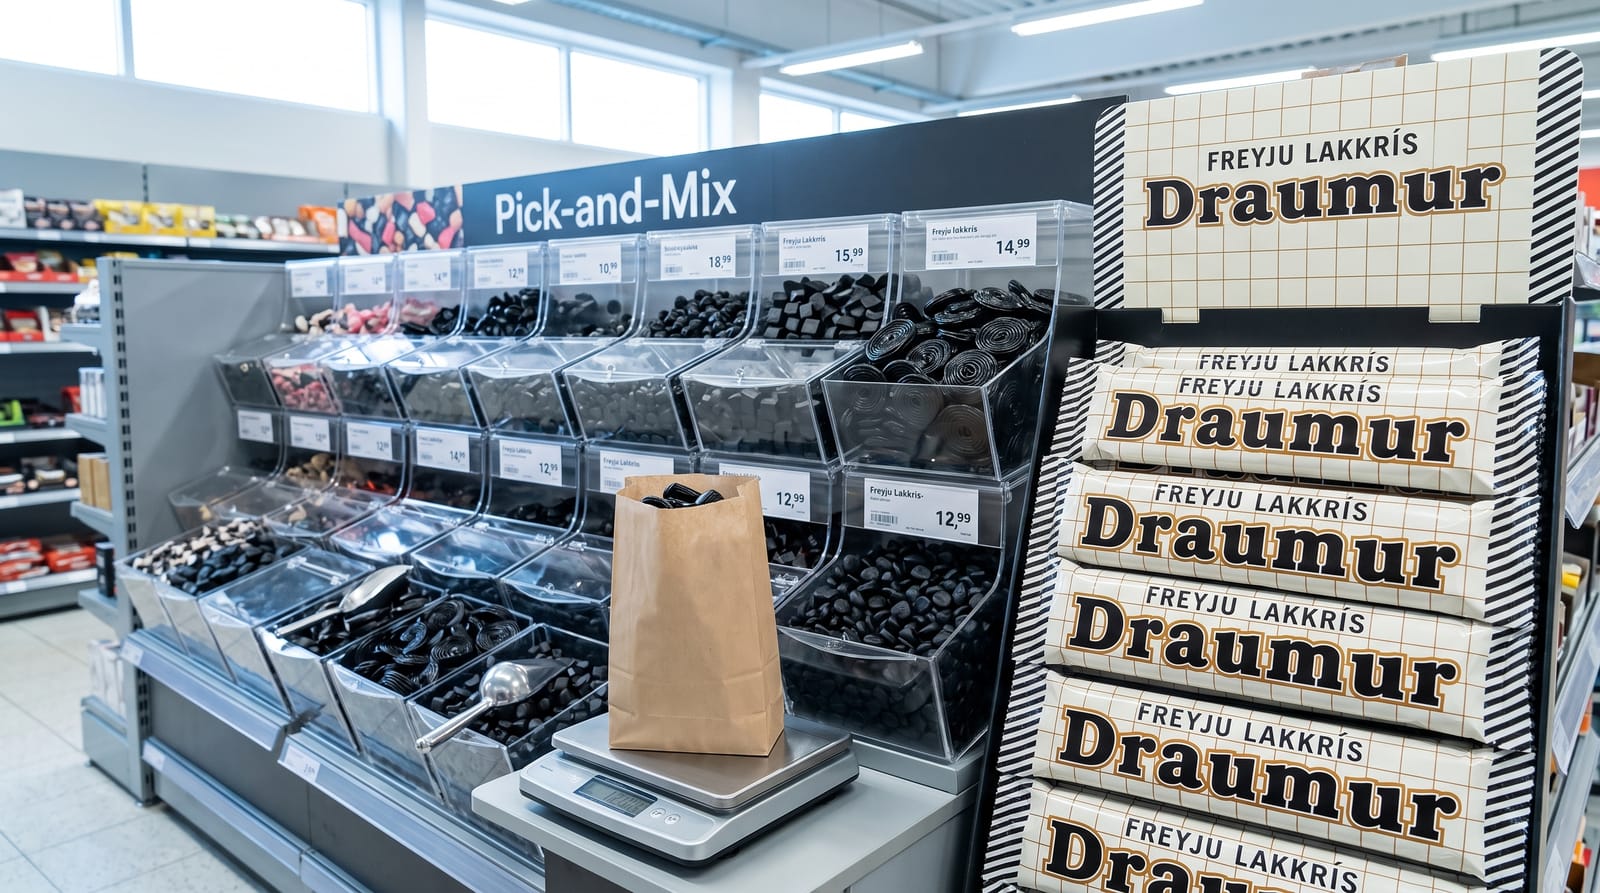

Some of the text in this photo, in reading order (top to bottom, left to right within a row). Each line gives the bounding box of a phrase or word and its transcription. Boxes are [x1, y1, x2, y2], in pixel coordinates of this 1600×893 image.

[1207, 128, 1418, 172] FREYJU LAKKRÍS
[495, 168, 737, 235] Pick-and-Mix
[1143, 162, 1506, 231] Draumur
[708, 255, 732, 269] 18,99
[835, 247, 863, 263] 15,99
[996, 238, 1030, 256] 14,99
[599, 262, 618, 275] 10,99
[1199, 352, 1390, 373] FREYJU LAKKRÍS
[1179, 377, 1382, 403] FREYJU LAKKRÍS
[1105, 390, 1470, 468] Draumur
[777, 491, 805, 508] 12,99
[870, 486, 892, 498] Freyju
[1155, 483, 1368, 522] FREYJU LAKKRÍS
[936, 510, 971, 530] 12,99
[1078, 494, 1461, 594] Draumur
[1145, 586, 1366, 634] FREYJU LAKKRÍS
[1065, 592, 1461, 710] Draumur
[1137, 702, 1364, 762] FREYJU LAKKRÍS
[1056, 705, 1462, 846] Draumur
[1124, 818, 1359, 893] FREYJU LAKKRÍS
